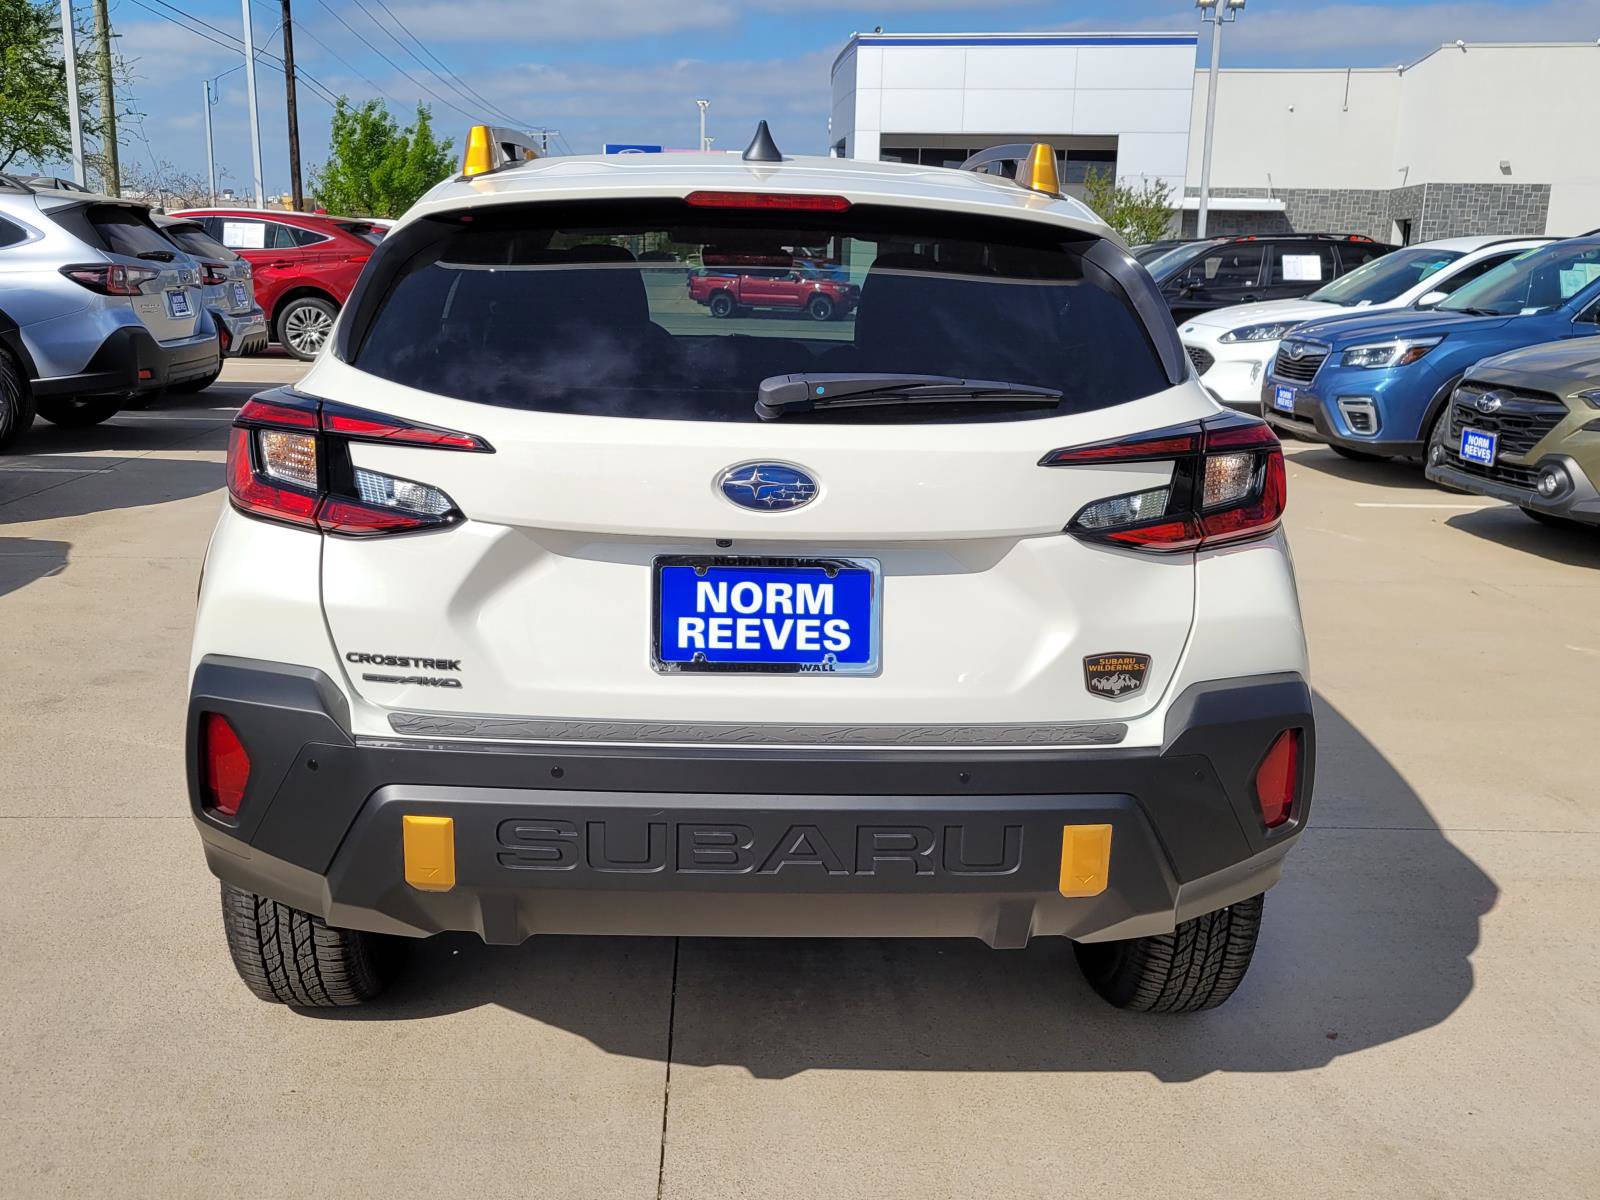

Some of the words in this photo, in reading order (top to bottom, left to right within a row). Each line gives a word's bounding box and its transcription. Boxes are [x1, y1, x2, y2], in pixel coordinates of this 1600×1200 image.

[1467, 435, 1490, 449] NORM
[1464, 444, 1491, 460] REEVES
[714, 556, 762, 566] NORM
[696, 581, 834, 615] NORM
[677, 617, 851, 651] REEVES
[346, 651, 462, 671] CROSSTREK
[1088, 664, 1146, 672] WILDERNESS
[1099, 657, 1136, 665] SUBARU
[496, 818, 1024, 876] SUBARU
